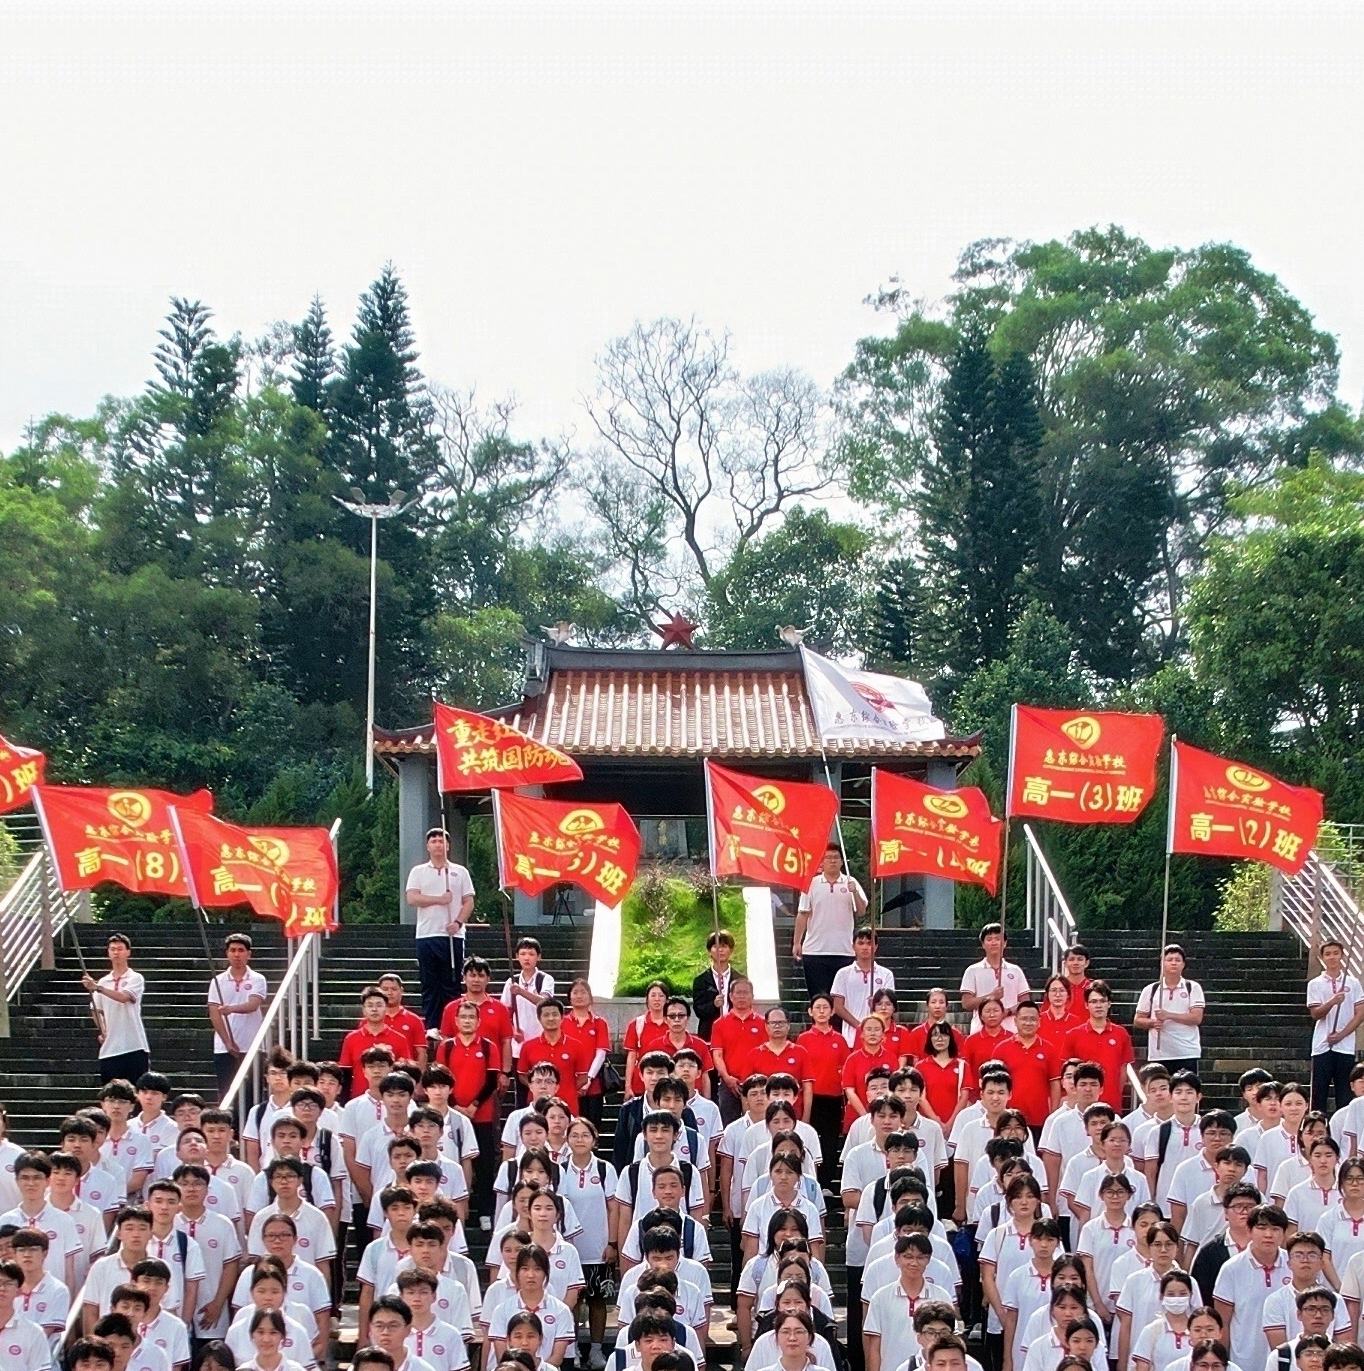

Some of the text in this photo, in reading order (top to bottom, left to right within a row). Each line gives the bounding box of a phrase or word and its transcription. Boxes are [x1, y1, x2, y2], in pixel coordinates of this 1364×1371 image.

[457, 745, 573, 776] 共筑国防魂
[1022, 776, 1144, 812] 高一(3)班
[1191, 812, 1304, 862] 高一(2)班
[75, 846, 188, 884] 高一(8)
